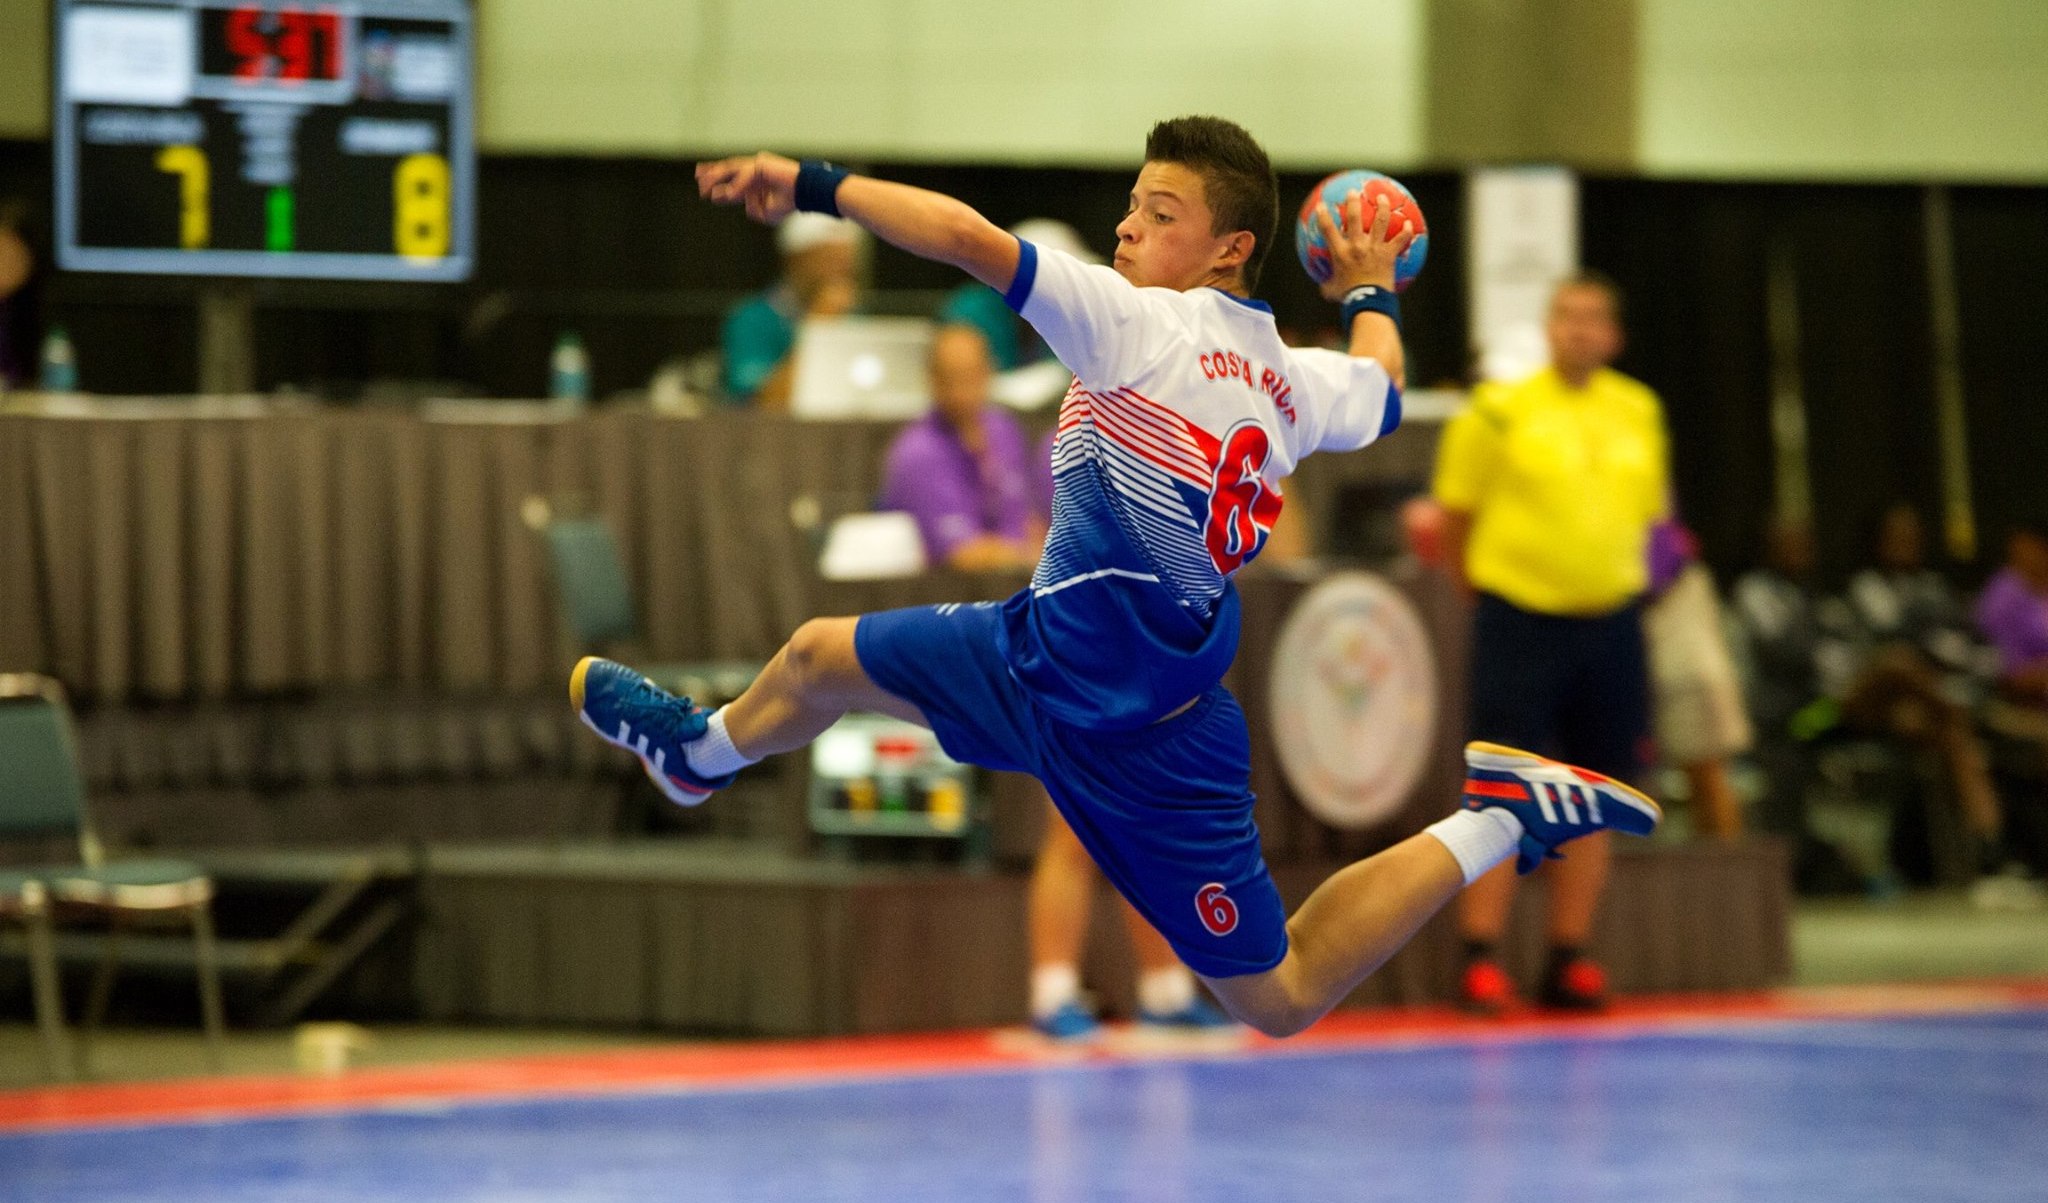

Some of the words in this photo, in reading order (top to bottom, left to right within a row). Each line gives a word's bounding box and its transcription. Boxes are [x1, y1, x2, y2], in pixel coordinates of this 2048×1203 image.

[393, 153, 451, 264] 8
[1200, 351, 1254, 388] COSA
[1203, 419, 1272, 576] 6
[1195, 882, 1239, 936] 6
